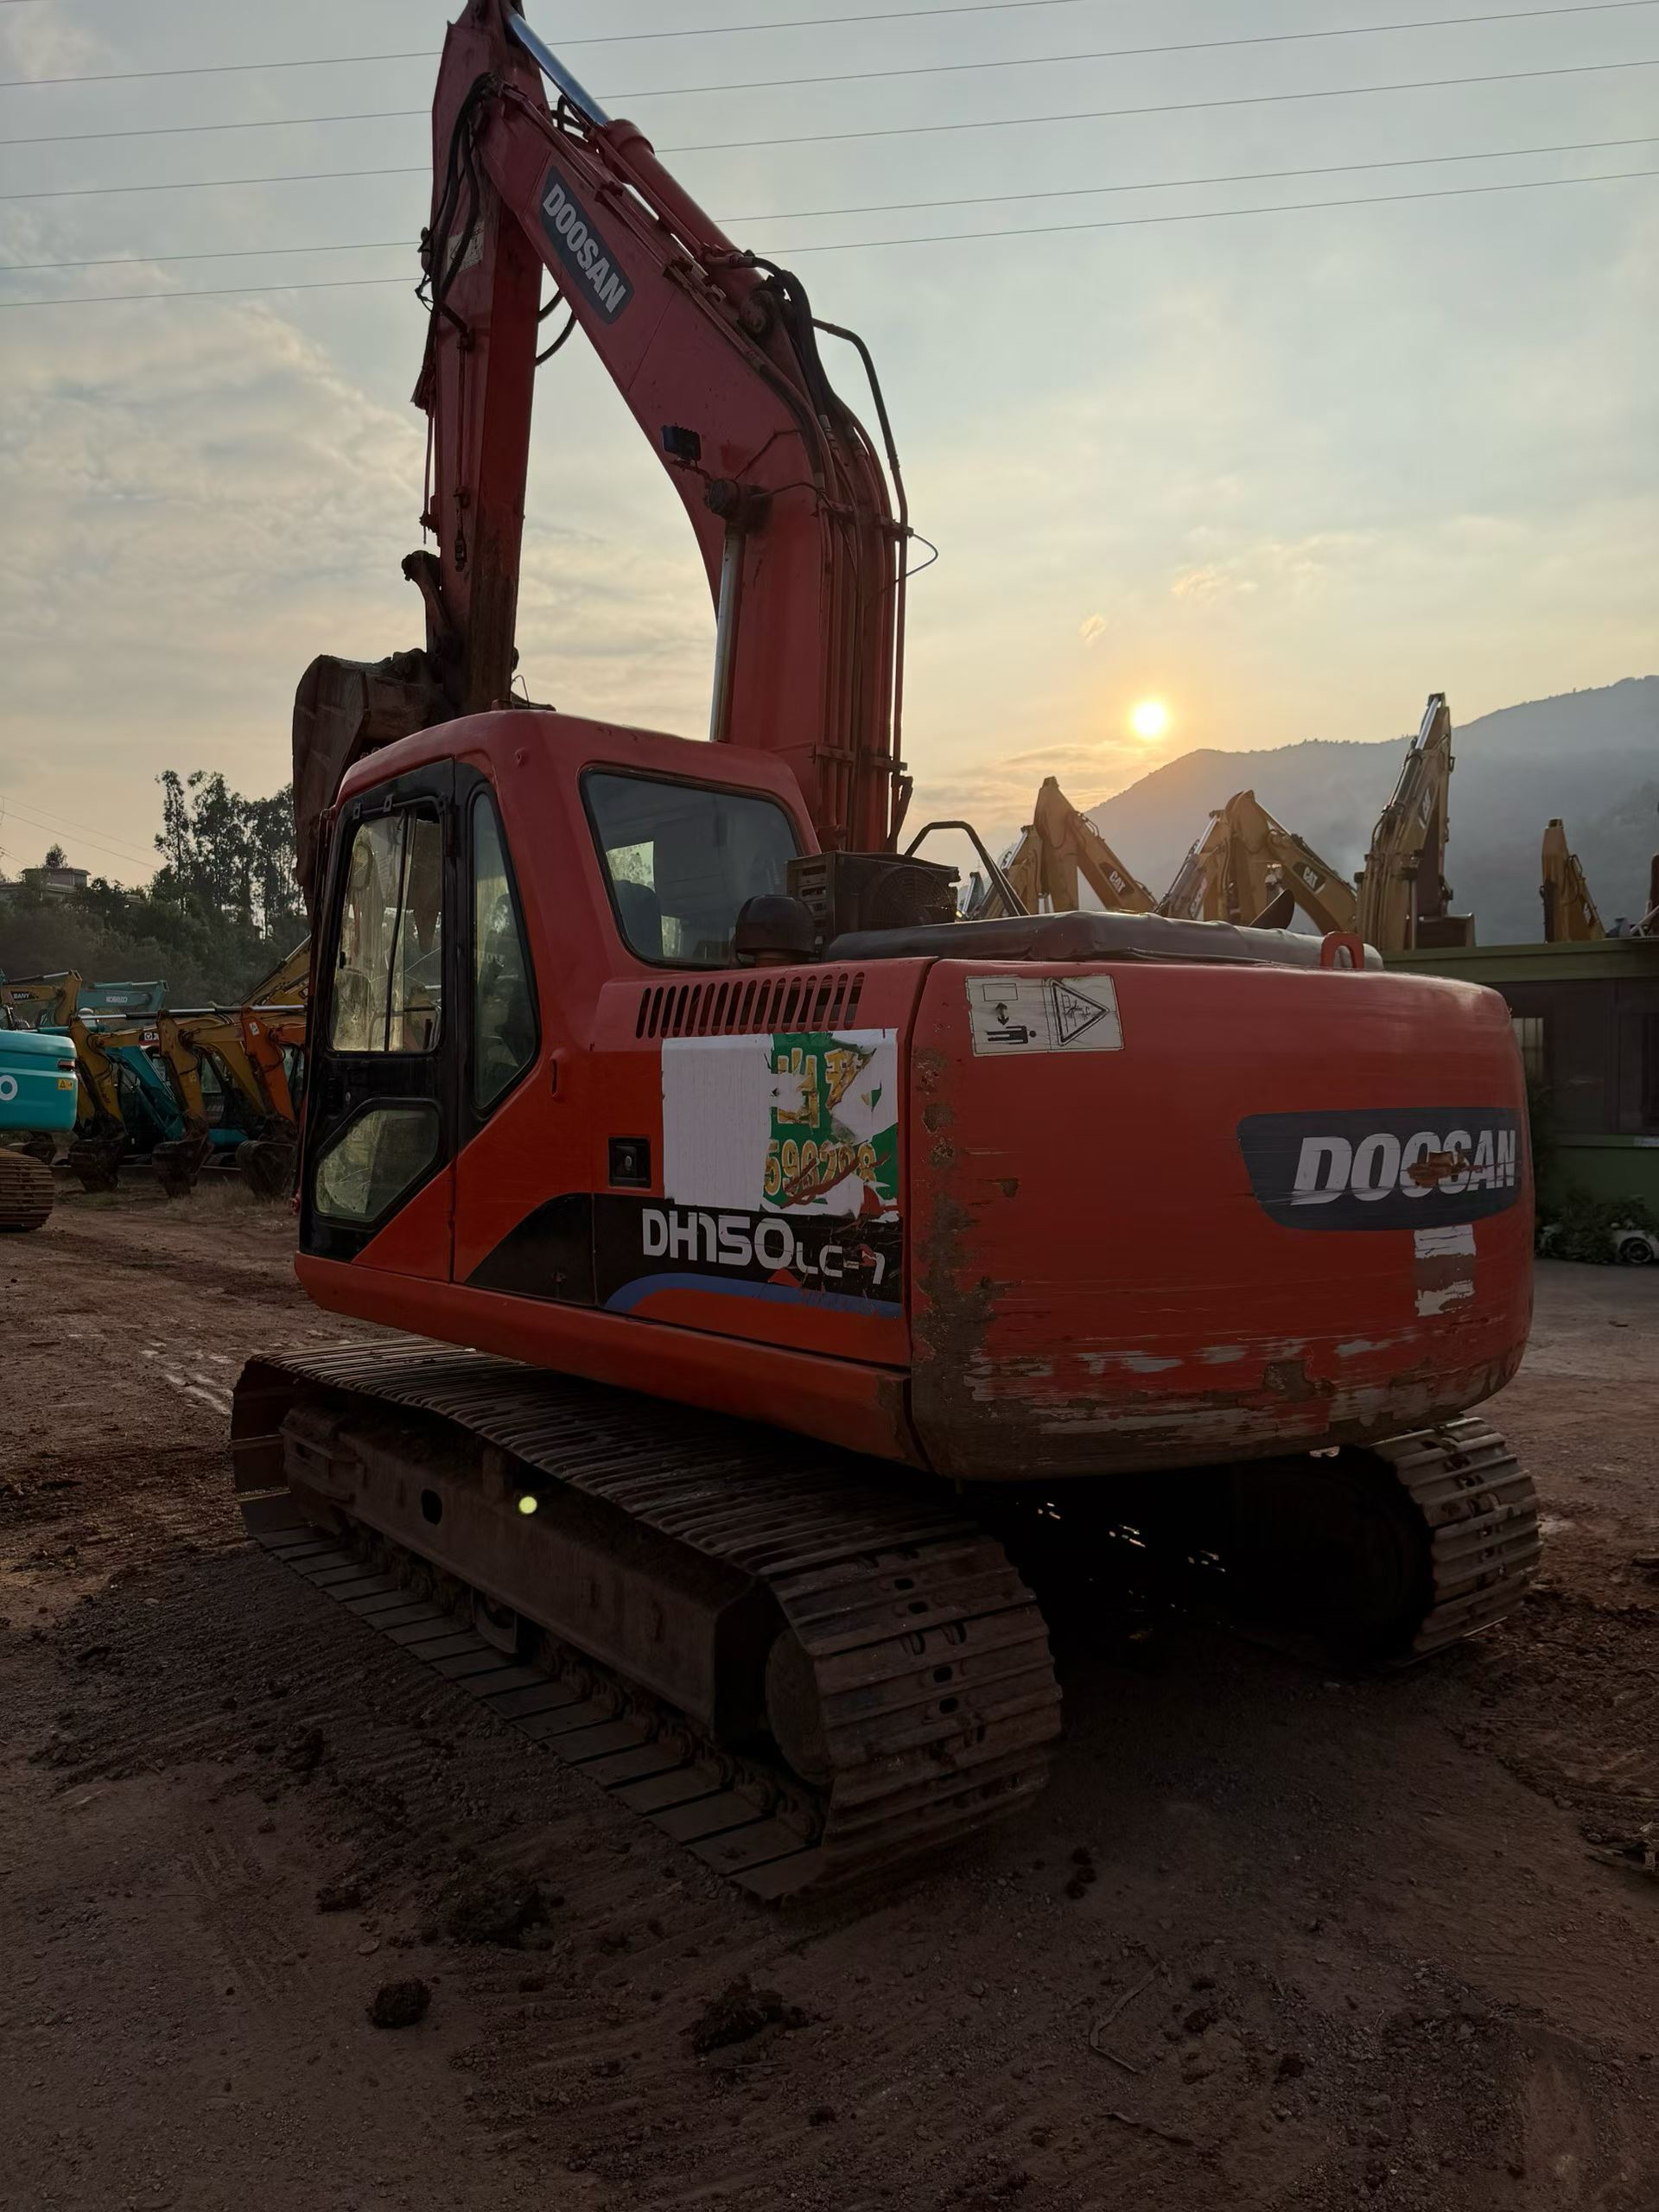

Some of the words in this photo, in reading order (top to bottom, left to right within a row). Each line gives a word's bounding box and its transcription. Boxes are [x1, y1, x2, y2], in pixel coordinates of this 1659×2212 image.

[543, 183, 626, 313] DOOSAN
[1109, 871, 1126, 893] CAT
[1303, 867, 1318, 888] CAT
[1290, 1130, 1516, 1205] DOOSAN
